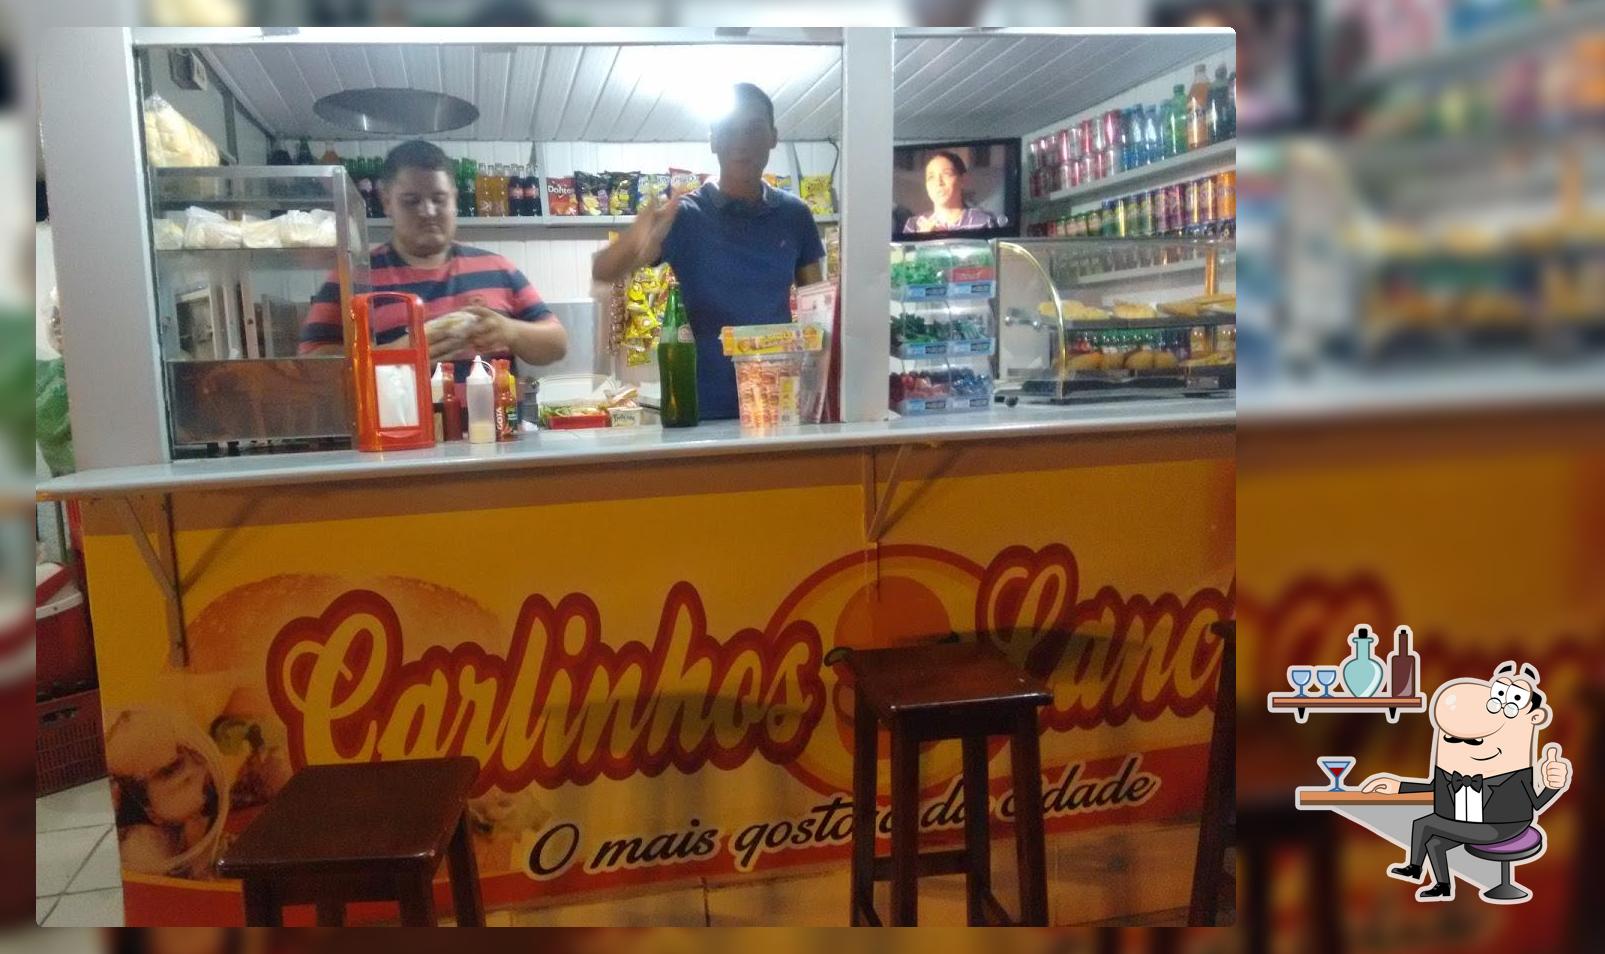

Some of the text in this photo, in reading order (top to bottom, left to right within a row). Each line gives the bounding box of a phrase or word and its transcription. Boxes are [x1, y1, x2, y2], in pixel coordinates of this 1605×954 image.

[273, 588, 818, 785] Carlinhos
[528, 820, 581, 877] O
[589, 817, 718, 870] mais
[734, 796, 893, 871] gostoo
[1001, 756, 1157, 817] cdade
